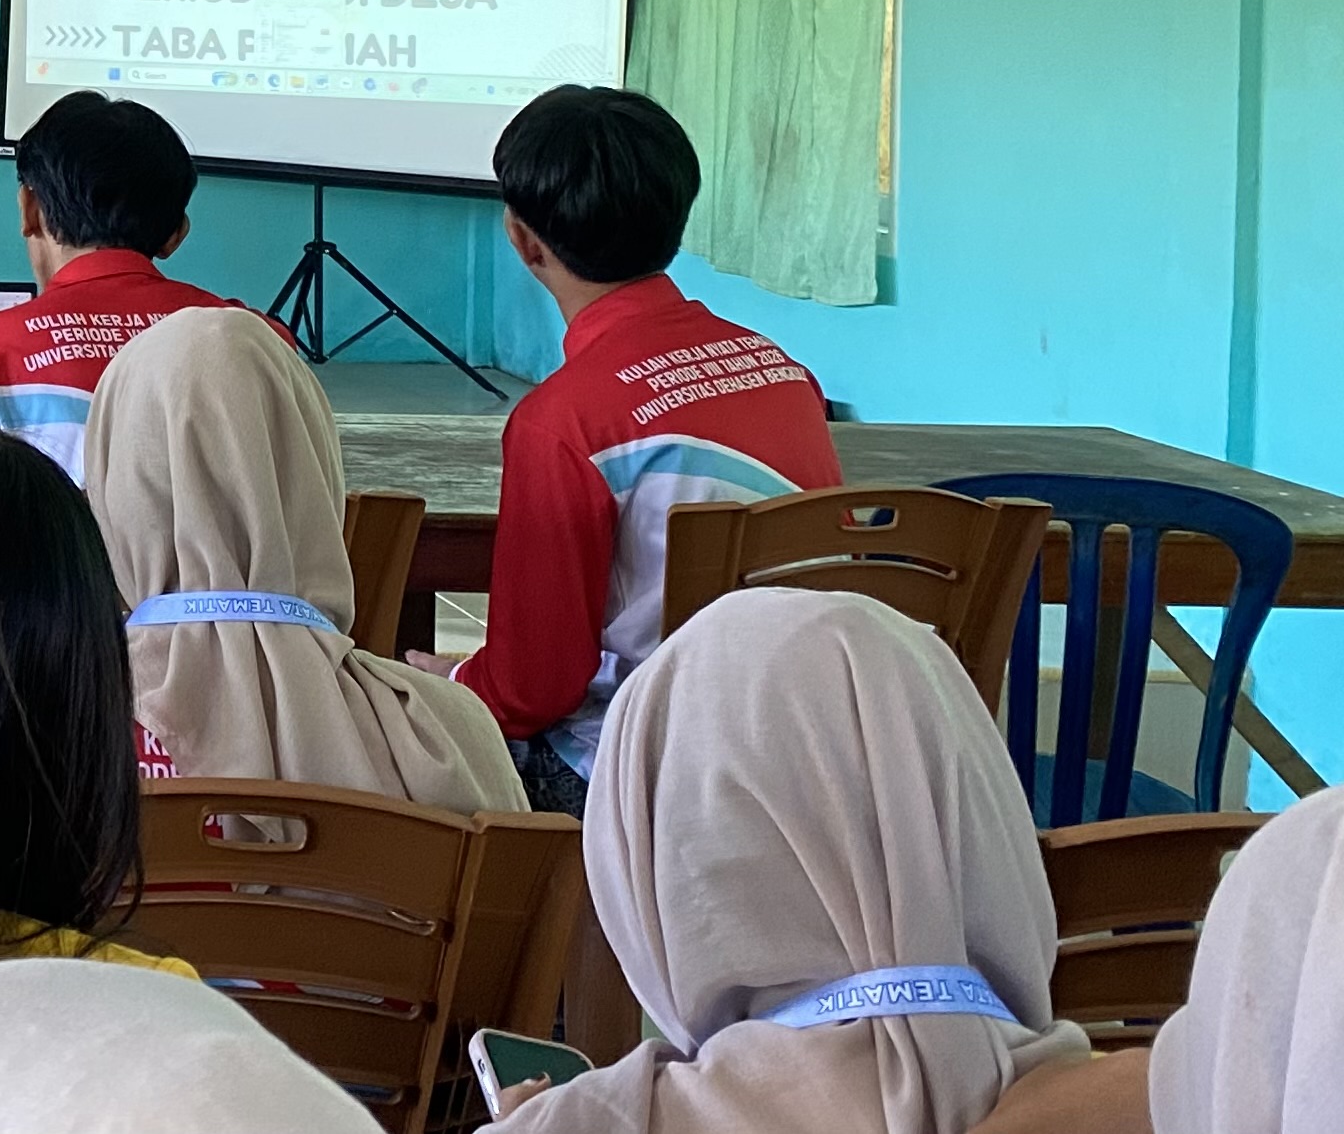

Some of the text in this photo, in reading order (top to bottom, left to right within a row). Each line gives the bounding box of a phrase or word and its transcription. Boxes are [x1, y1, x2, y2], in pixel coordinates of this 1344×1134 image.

[112, 25, 227, 61] TABA
[25, 313, 87, 332] KULIAH
[88, 313, 145, 327] KERJA
[50, 327, 125, 344] PERIODE
[616, 355, 673, 384] KULIAH
[665, 345, 708, 365] KERJA
[703, 340, 740, 359] NYATA
[647, 364, 706, 393] PERIODE
[719, 354, 760, 373] TAHUN
[754, 348, 786, 366] 2026
[631, 382, 718, 426] UNIVERSITAS
[713, 370, 768, 395] DEHASEN
[185, 598, 274, 614] TEMATIK
[817, 979, 954, 1015] TEMATIK
